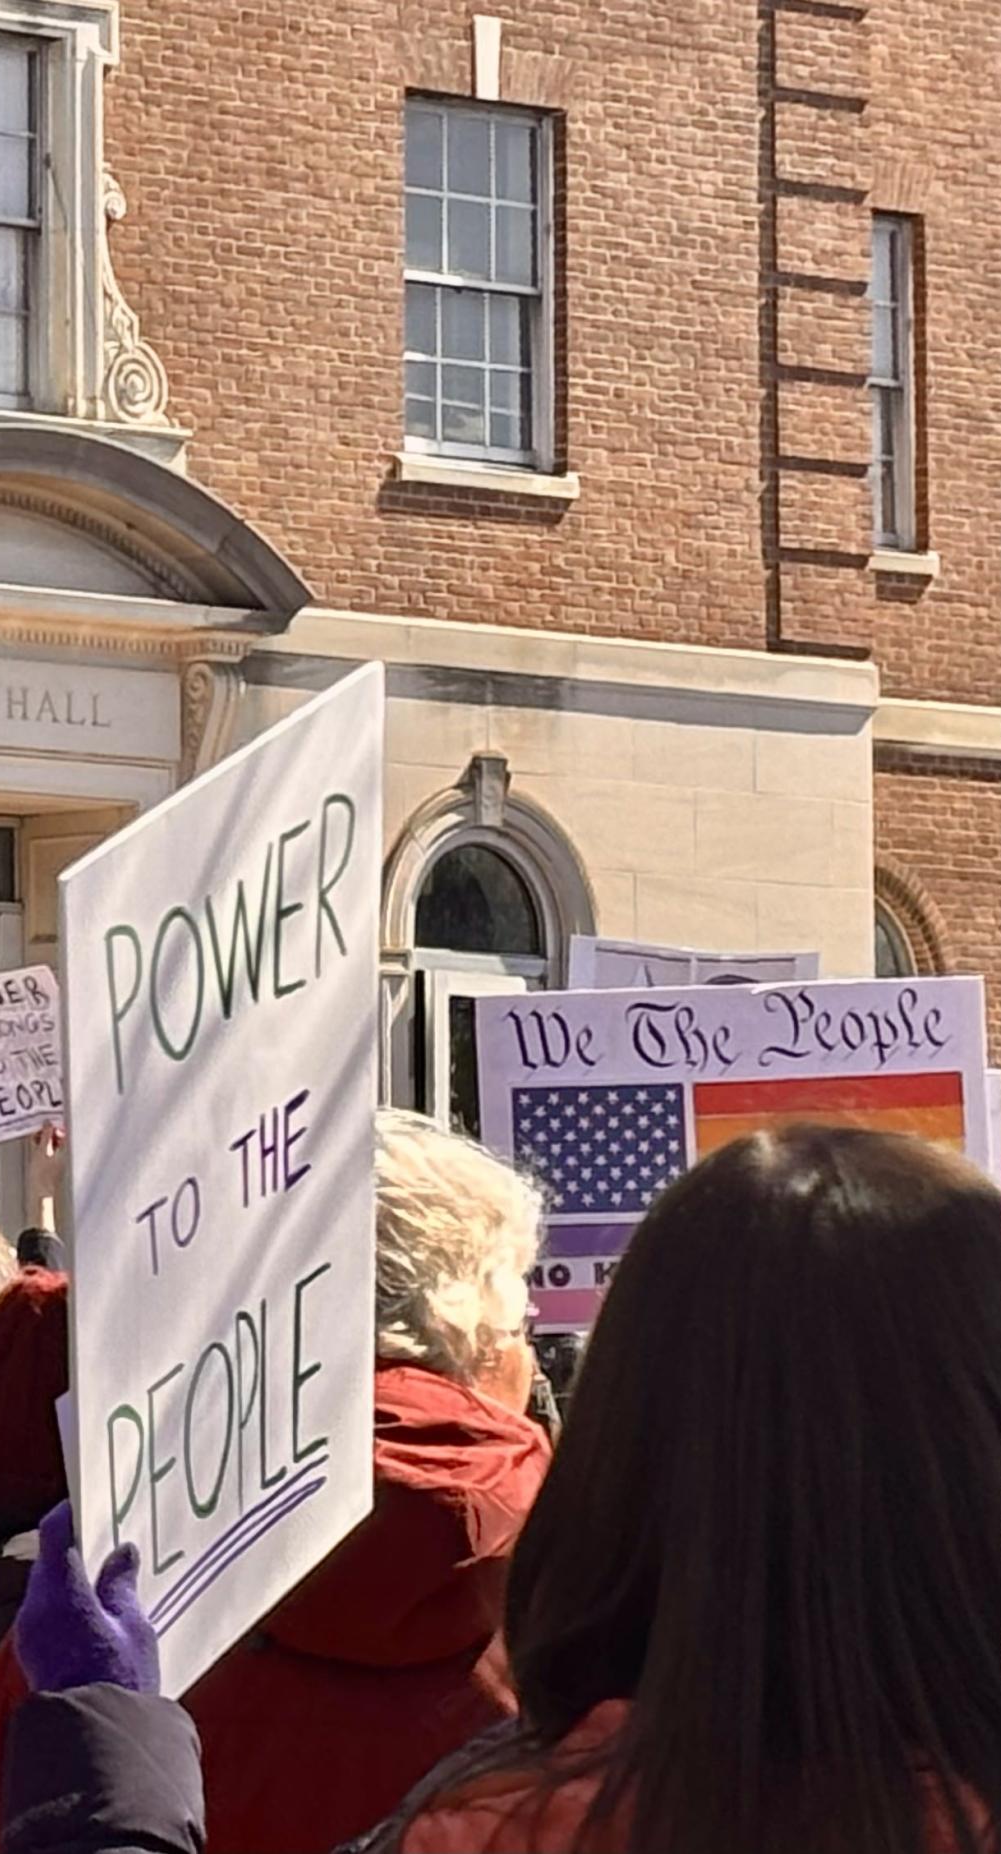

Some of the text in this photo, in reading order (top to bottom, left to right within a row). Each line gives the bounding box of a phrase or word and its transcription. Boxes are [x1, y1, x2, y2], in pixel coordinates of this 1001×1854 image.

[6, 686, 111, 727] HALL
[103, 793, 356, 1095] POWER
[9, 1044, 58, 1071] THE
[503, 988, 952, 1070] We The People
[136, 1089, 311, 1276] TO THE
[107, 1262, 331, 1576] PEOPLE
